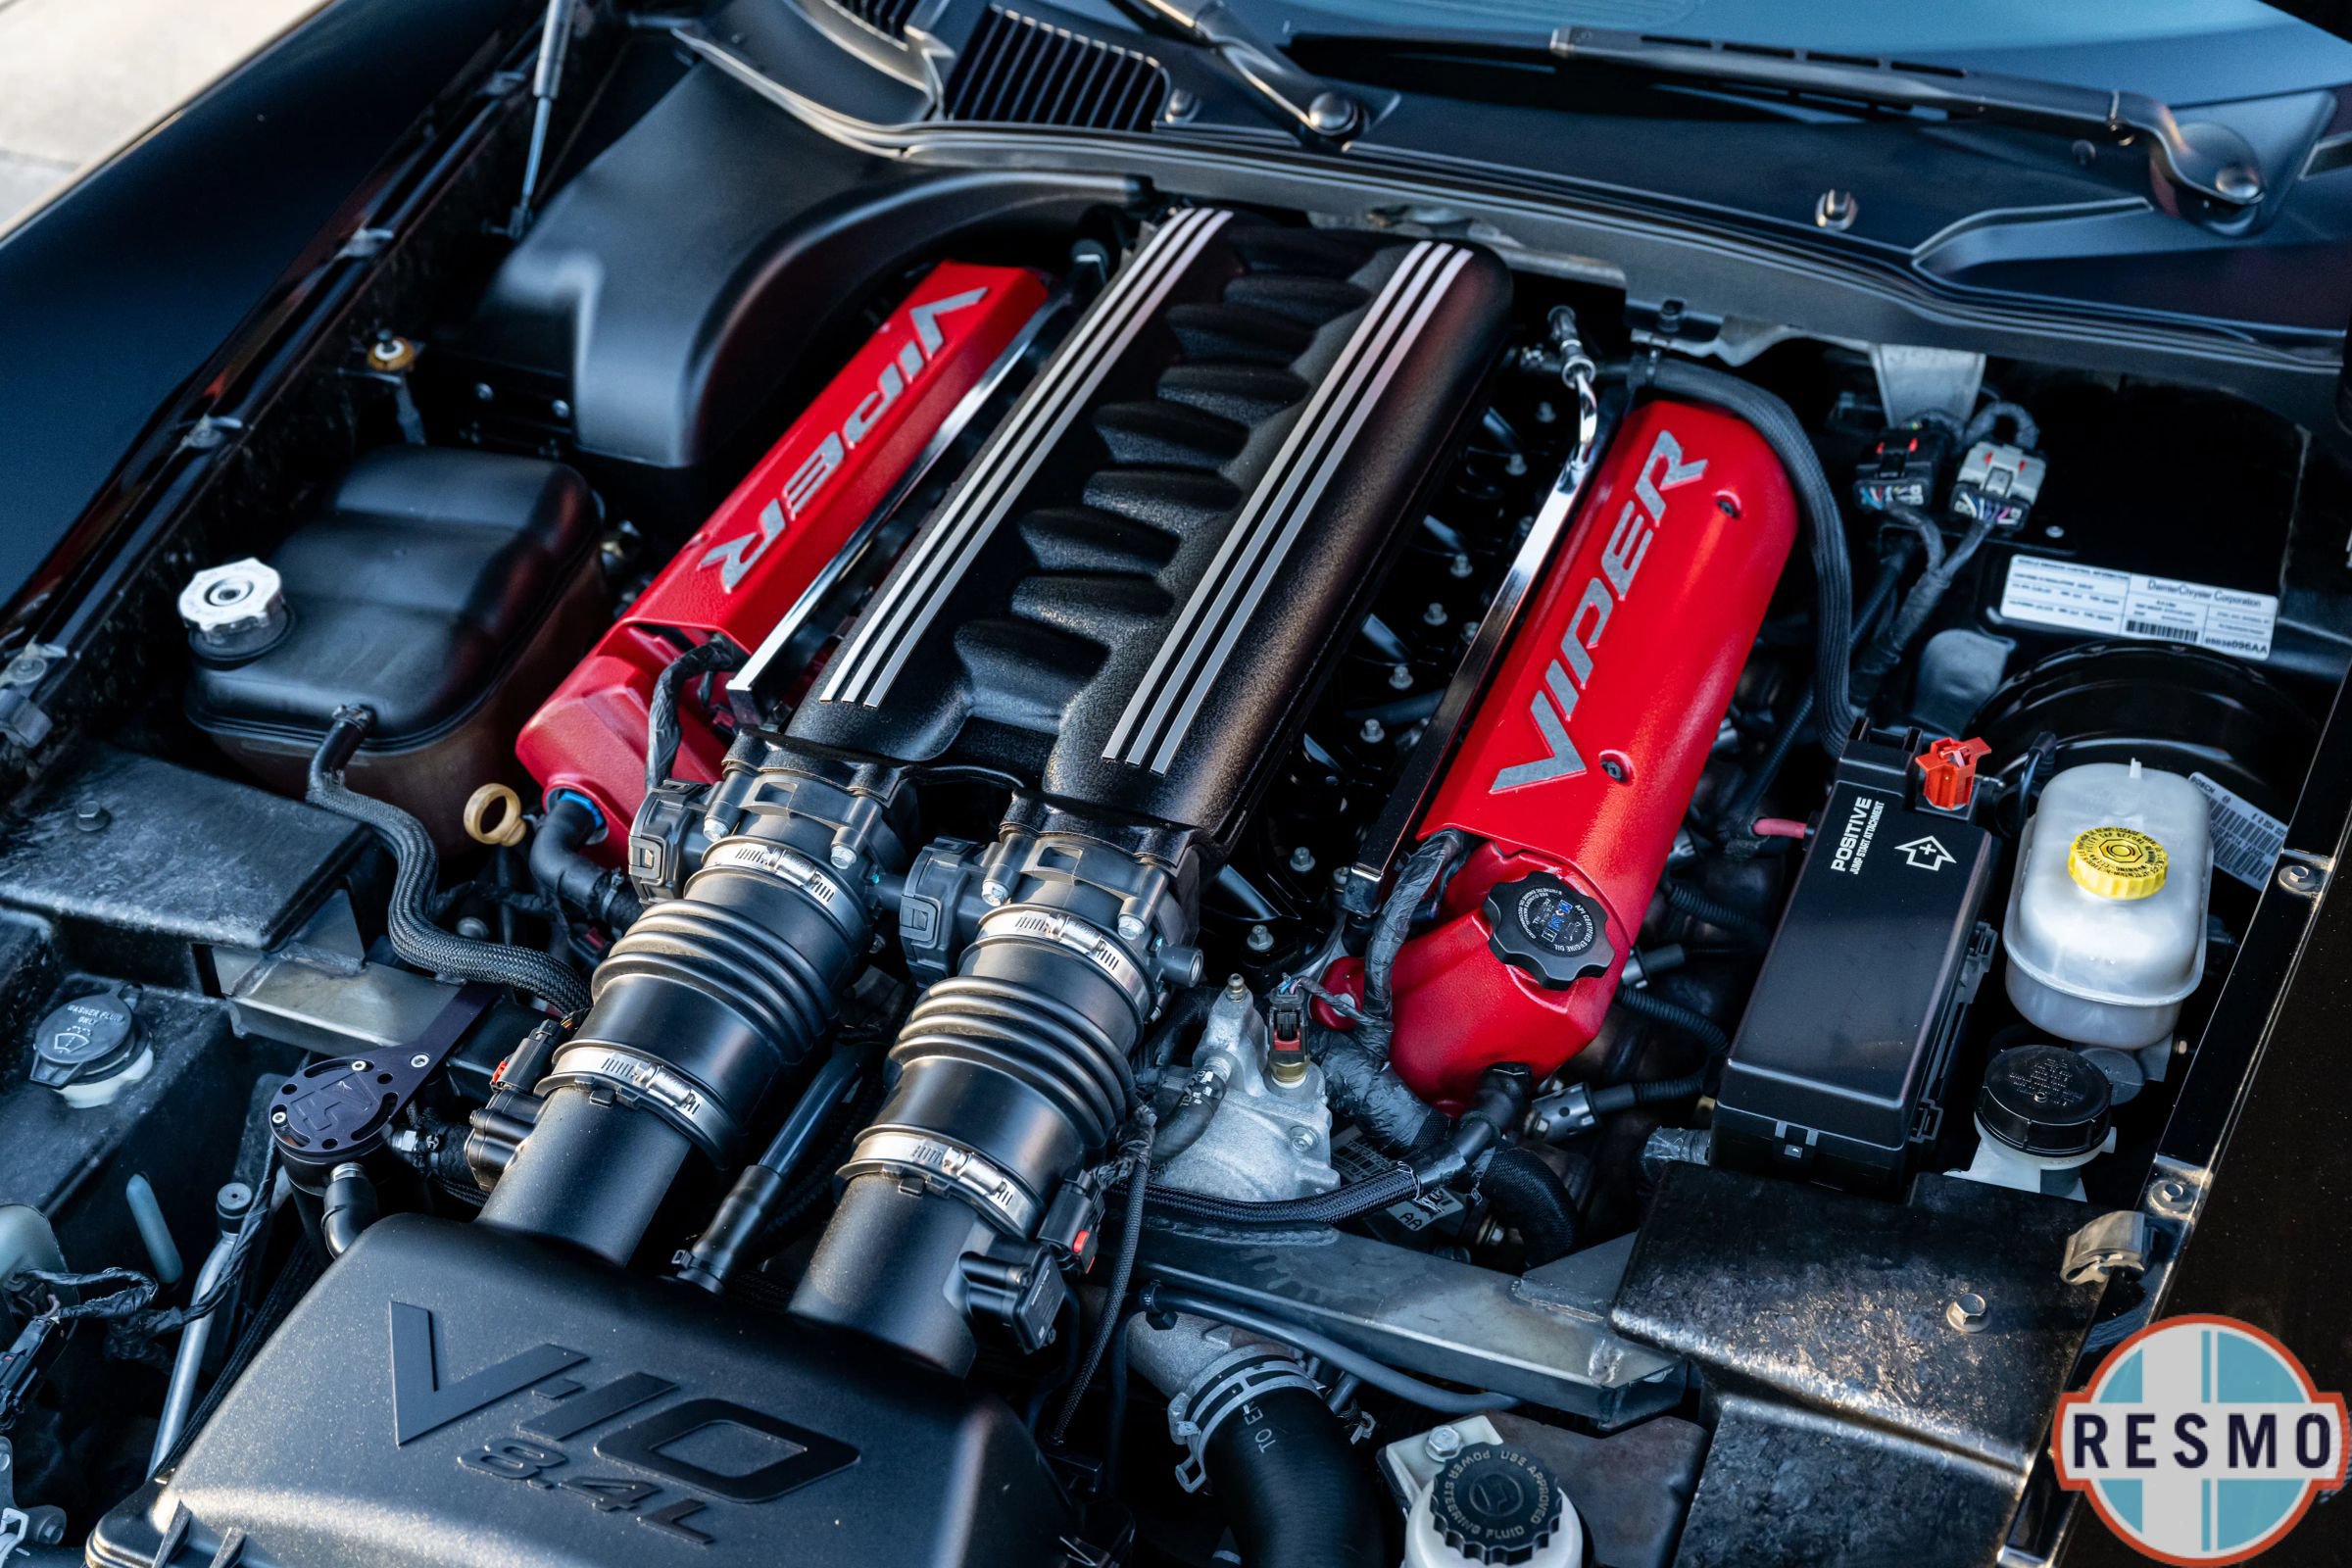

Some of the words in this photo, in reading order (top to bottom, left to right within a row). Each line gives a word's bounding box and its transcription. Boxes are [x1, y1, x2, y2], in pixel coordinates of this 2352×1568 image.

[696, 286, 988, 594] VIPER
[1489, 429, 1708, 795] VIPER
[2214, 590, 2262, 608] Corporation
[1831, 796, 1872, 872] POSITIVE
[1849, 857, 1863, 874] JUMP
[1856, 838, 1870, 858] START
[1863, 801, 1885, 840] ATTACHMENT
[1575, 904, 1586, 915] API
[1583, 914, 1593, 943] CERTIFIED
[1567, 940, 1589, 953] ENGINE
[67, 1004, 99, 1018] WASHER
[99, 1010, 124, 1022] FLUID
[77, 1016, 98, 1026] ONLY
[1254, 1428, 1276, 1453] TO
[1447, 1449, 1491, 1480] POWER
[458, 1437, 715, 1545] 8.4L
[1500, 1449, 1528, 1467] USE
[1526, 1465, 1549, 1525] APPROVED
[1444, 1481, 1482, 1535] STEERING
[1486, 1525, 1525, 1540] FLUID
